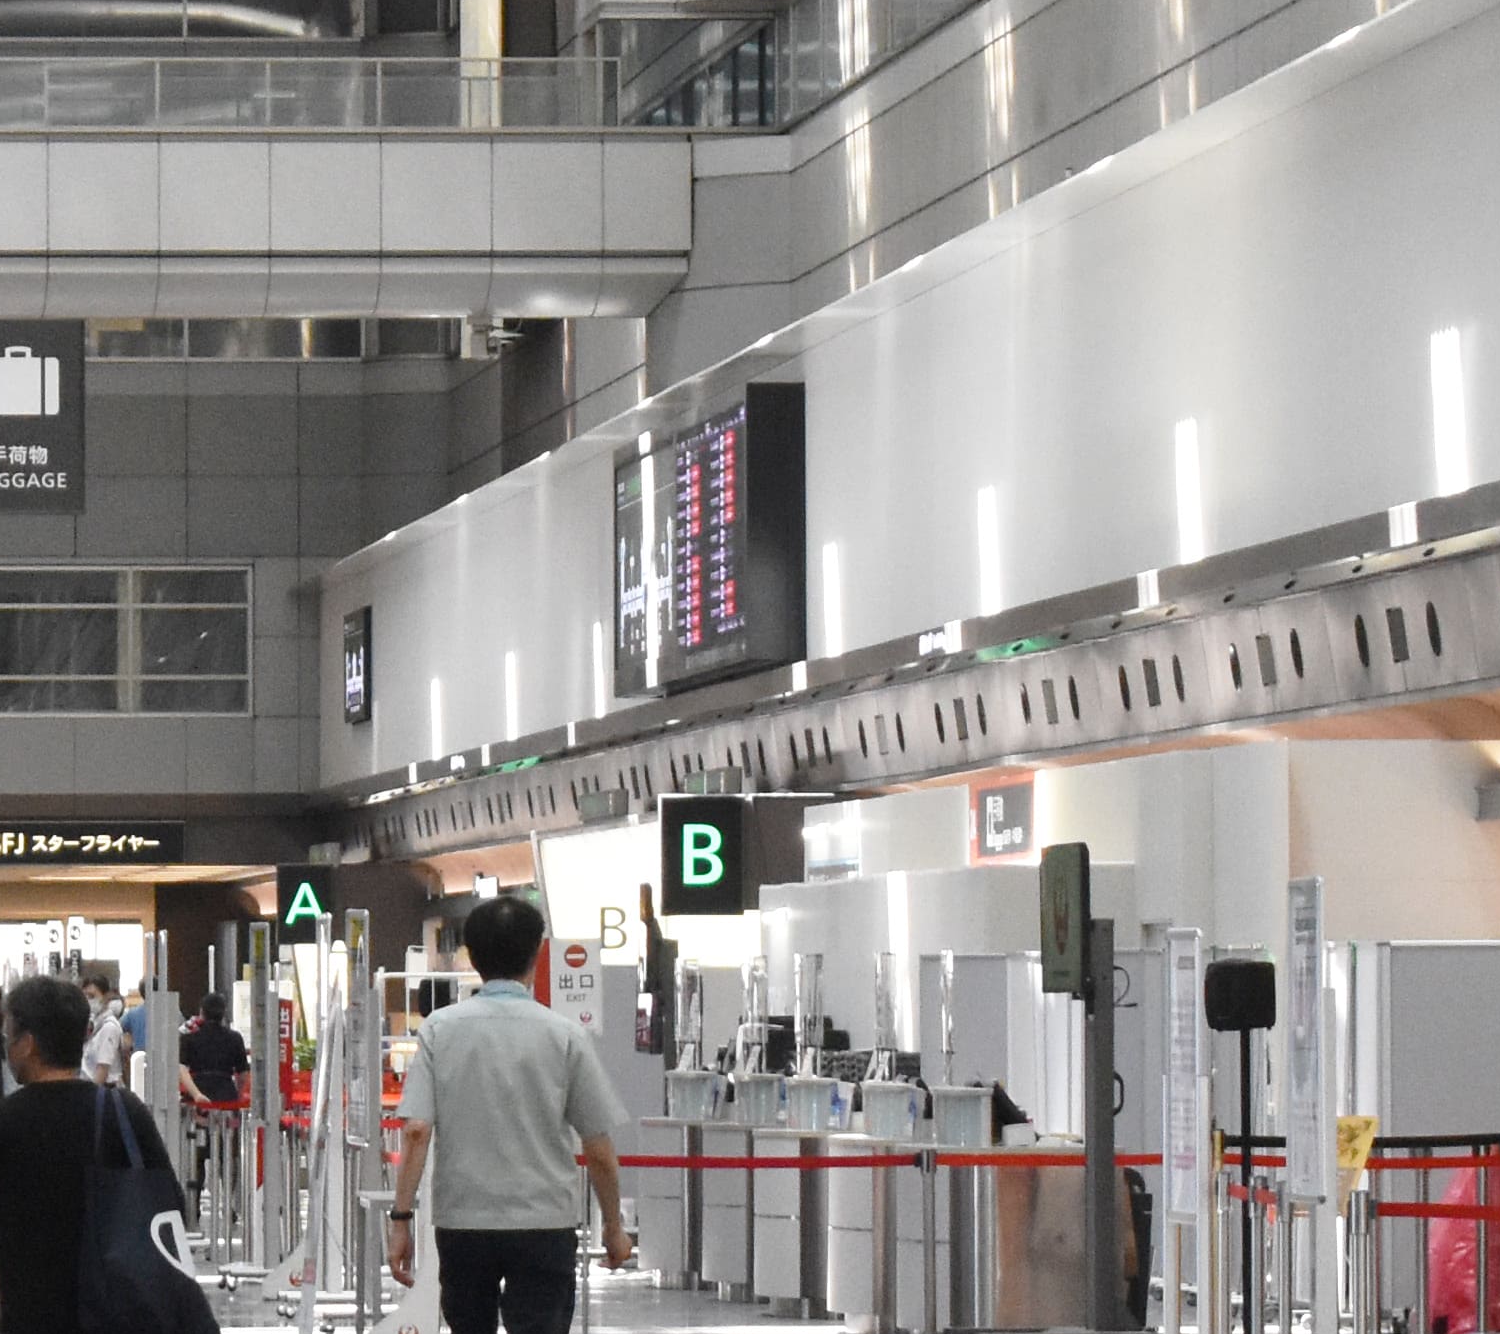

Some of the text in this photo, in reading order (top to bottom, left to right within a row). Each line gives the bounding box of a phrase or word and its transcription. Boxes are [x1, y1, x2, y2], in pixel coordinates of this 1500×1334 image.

[31, 834, 160, 852] スターフライヤー
[682, 822, 724, 886] B
[285, 882, 322, 924] A
[600, 906, 628, 949] B
[558, 973, 594, 989] 出口
